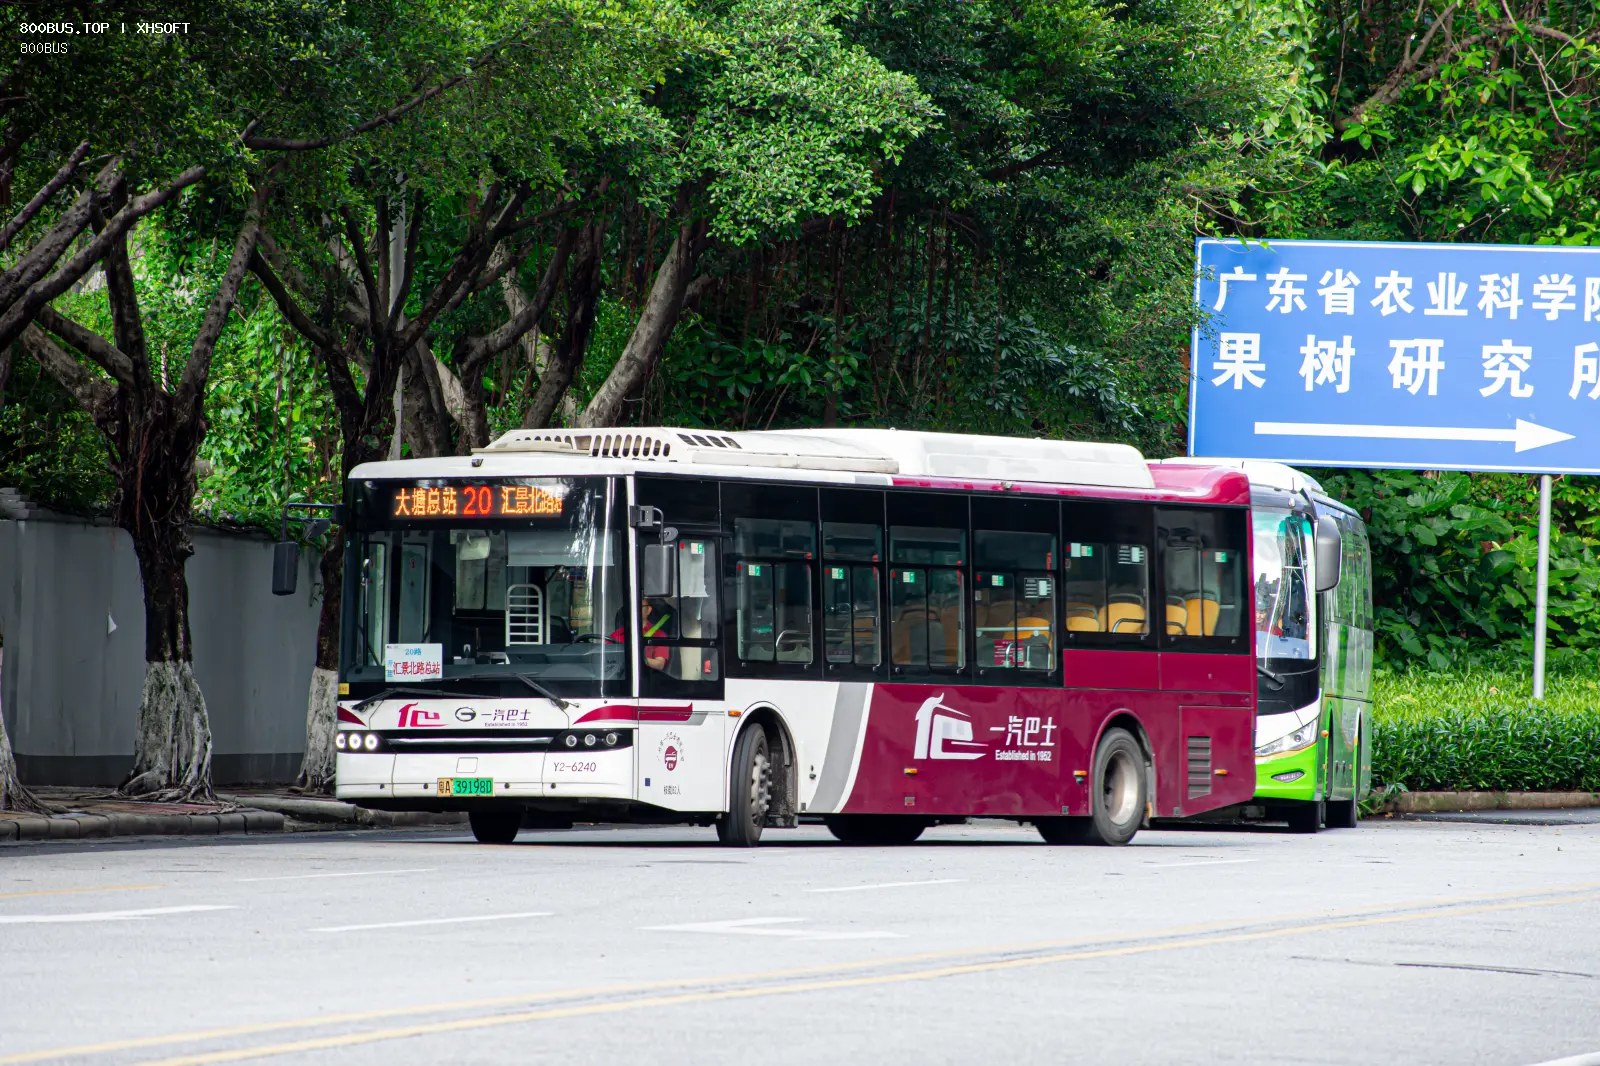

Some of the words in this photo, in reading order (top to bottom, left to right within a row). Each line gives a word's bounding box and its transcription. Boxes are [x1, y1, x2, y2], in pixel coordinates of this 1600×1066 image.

[394, 486, 458, 516] 大塘总站
[463, 485, 493, 516] 20
[393, 661, 441, 675] 汇景北路总站
[481, 708, 532, 721] 一汽巴士
[989, 715, 1058, 747] 一汽巴士
[995, 749, 1030, 761] Established
[1029, 750, 1036, 761] in
[1037, 750, 1052, 762] 1952
[553, 761, 597, 772] Y2-6240
